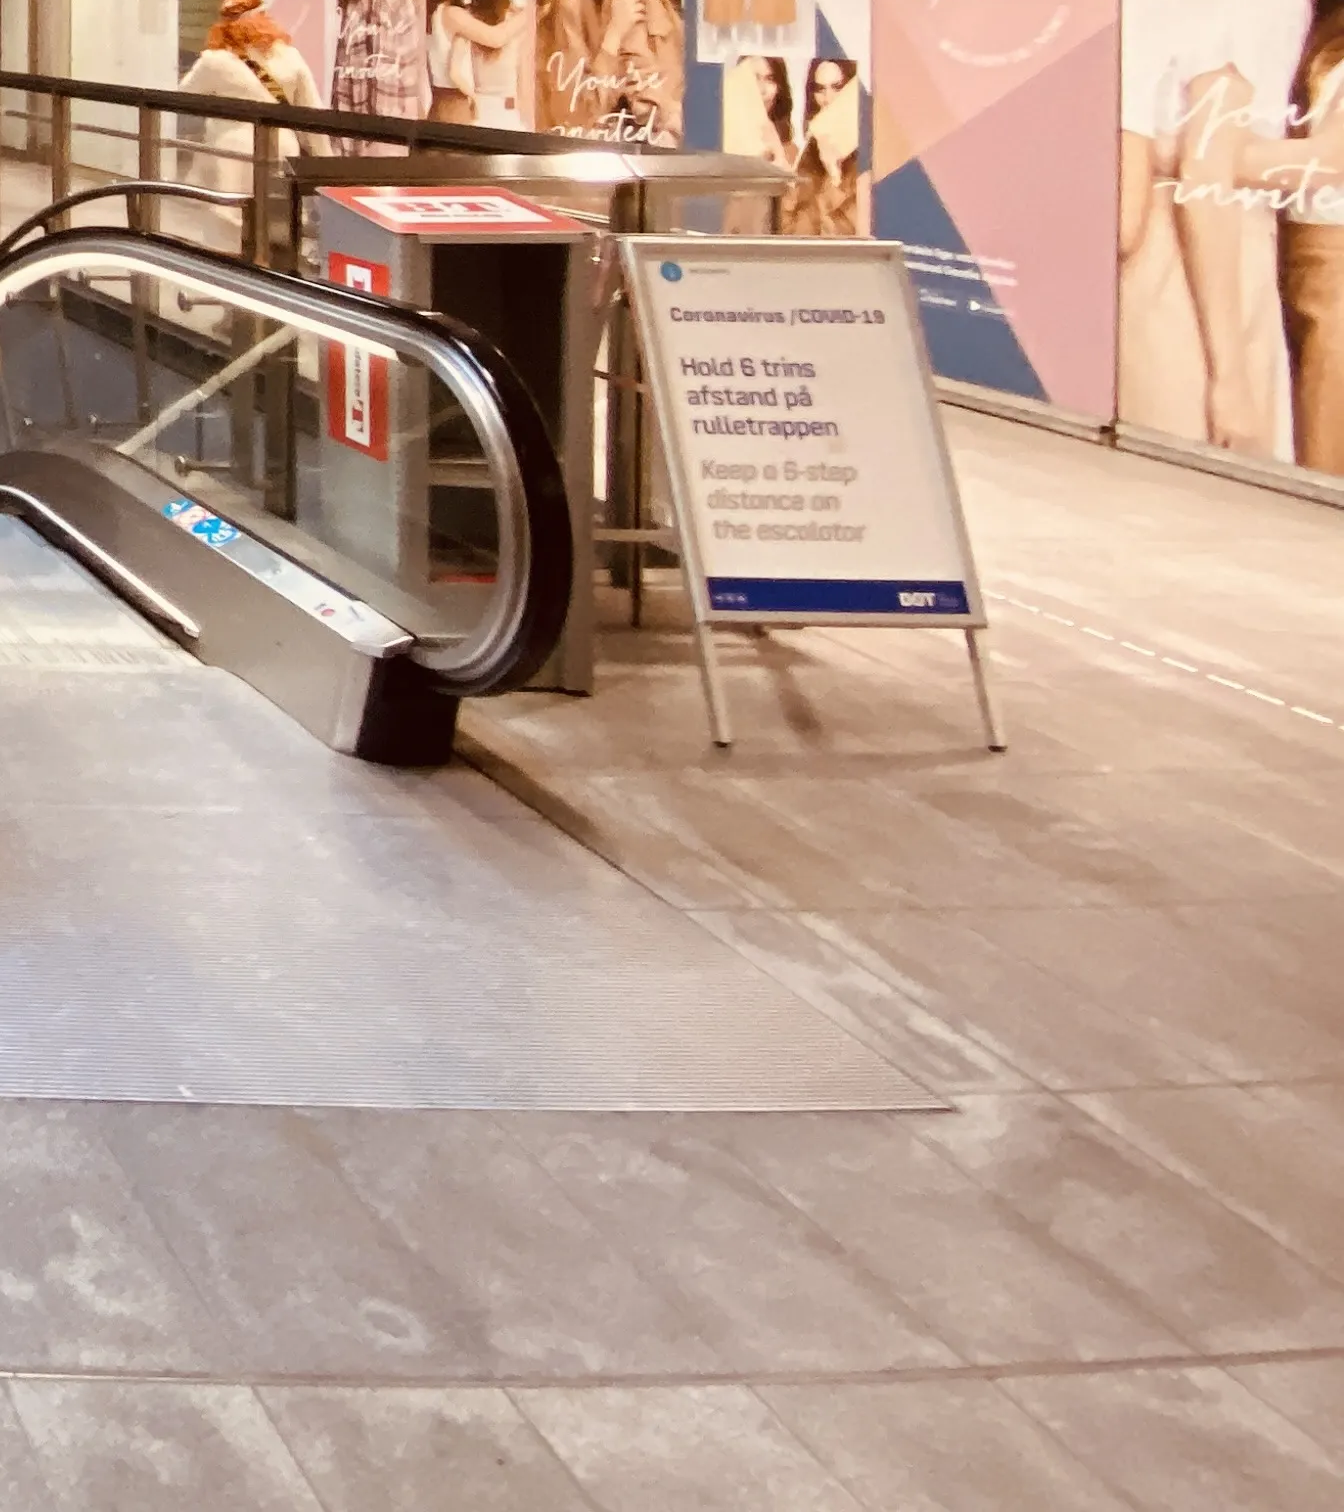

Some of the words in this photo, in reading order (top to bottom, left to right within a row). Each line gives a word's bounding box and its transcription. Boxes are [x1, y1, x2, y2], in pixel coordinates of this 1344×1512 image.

[546, 51, 668, 113] You're
[1153, 159, 1344, 214] invite
[670, 306, 786, 324] Coronavirus
[681, 357, 734, 377] Hold
[740, 357, 756, 377] 6
[761, 357, 817, 378] trins
[687, 385, 778, 406] afstand
[784, 385, 813, 410] på
[692, 416, 839, 440] rulletrappen
[702, 460, 757, 483] Keep
[762, 464, 779, 481] a
[708, 490, 805, 510] distance
[811, 494, 840, 511] on
[713, 519, 751, 539] the
[757, 522, 868, 542] escalator
